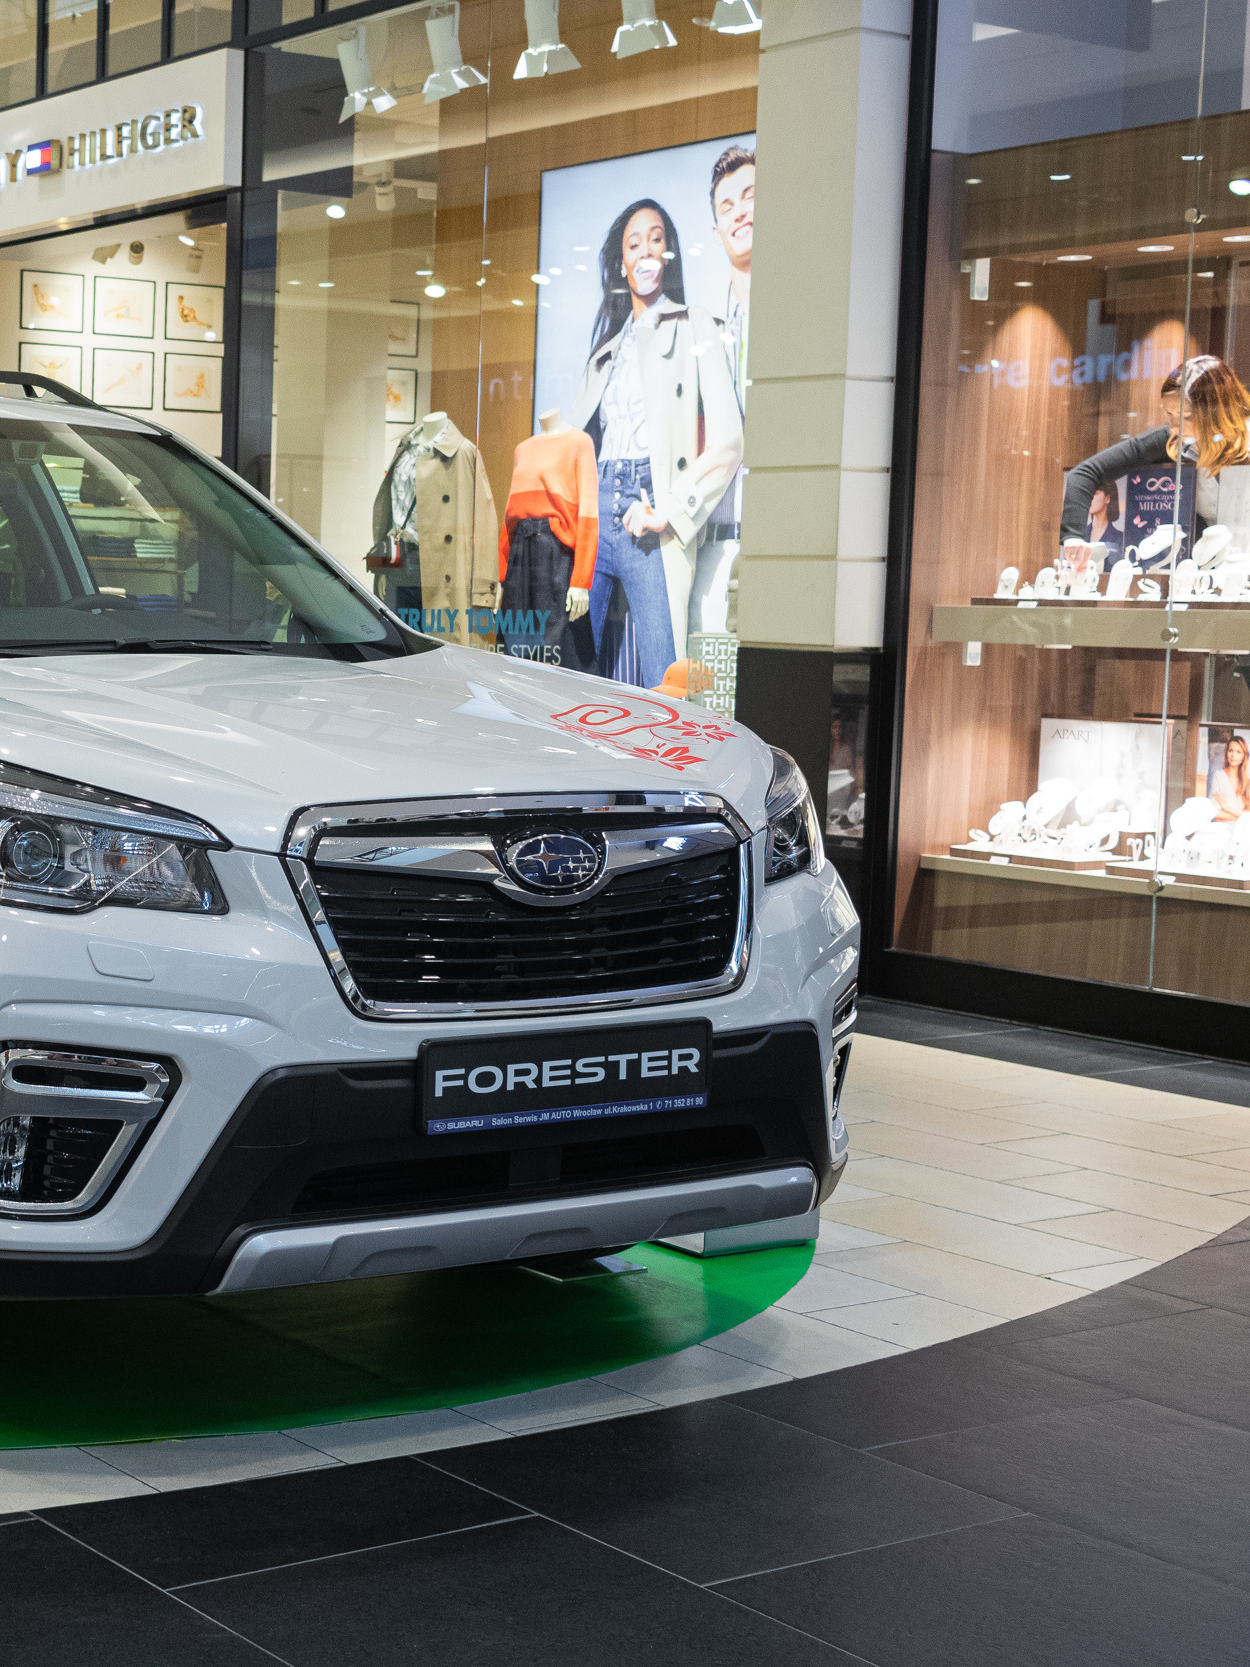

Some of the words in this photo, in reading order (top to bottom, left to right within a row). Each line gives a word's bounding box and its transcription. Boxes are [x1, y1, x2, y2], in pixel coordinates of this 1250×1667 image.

[67, 105, 200, 169] HILFIGER
[397, 608, 459, 634] TRULY
[466, 608, 552, 635] TOMMY
[511, 644, 562, 666] STYLES
[1051, 728, 1092, 743] APART
[434, 1047, 701, 1097] FORESTER
[447, 1119, 484, 1129] SUBARU
[491, 1117, 512, 1126] Salon
[514, 1115, 538, 1123] Serwis
[539, 1112, 550, 1121] JM
[551, 1110, 571, 1119] AUTO
[604, 1103, 648, 1115] ul.Krakowska
[665, 1100, 672, 1108] 71
[674, 1099, 686, 1107] 352
[686, 1098, 694, 1106] 81
[695, 1097, 704, 1105] 90
